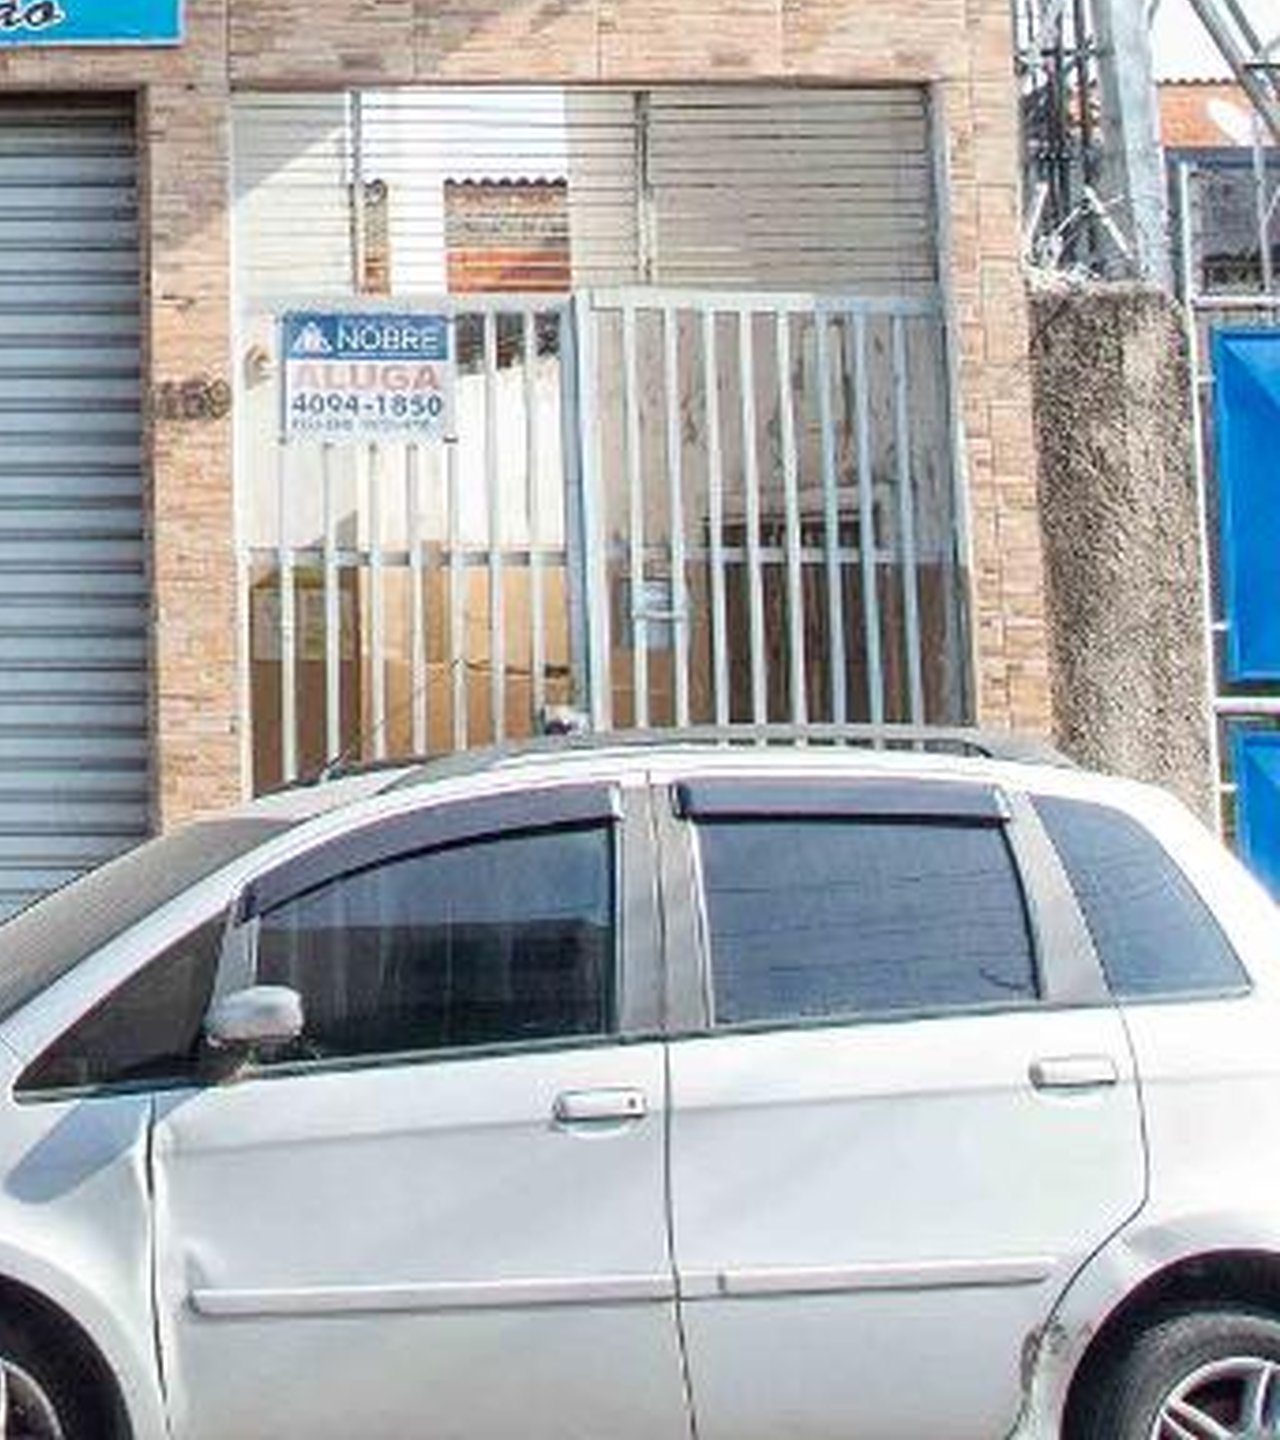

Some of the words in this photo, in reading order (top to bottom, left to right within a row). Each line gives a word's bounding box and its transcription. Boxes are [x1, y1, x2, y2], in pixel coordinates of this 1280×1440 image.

[336, 324, 440, 351] NOBRE
[293, 364, 440, 391] ALUGA
[291, 392, 444, 418] 4094-1850
